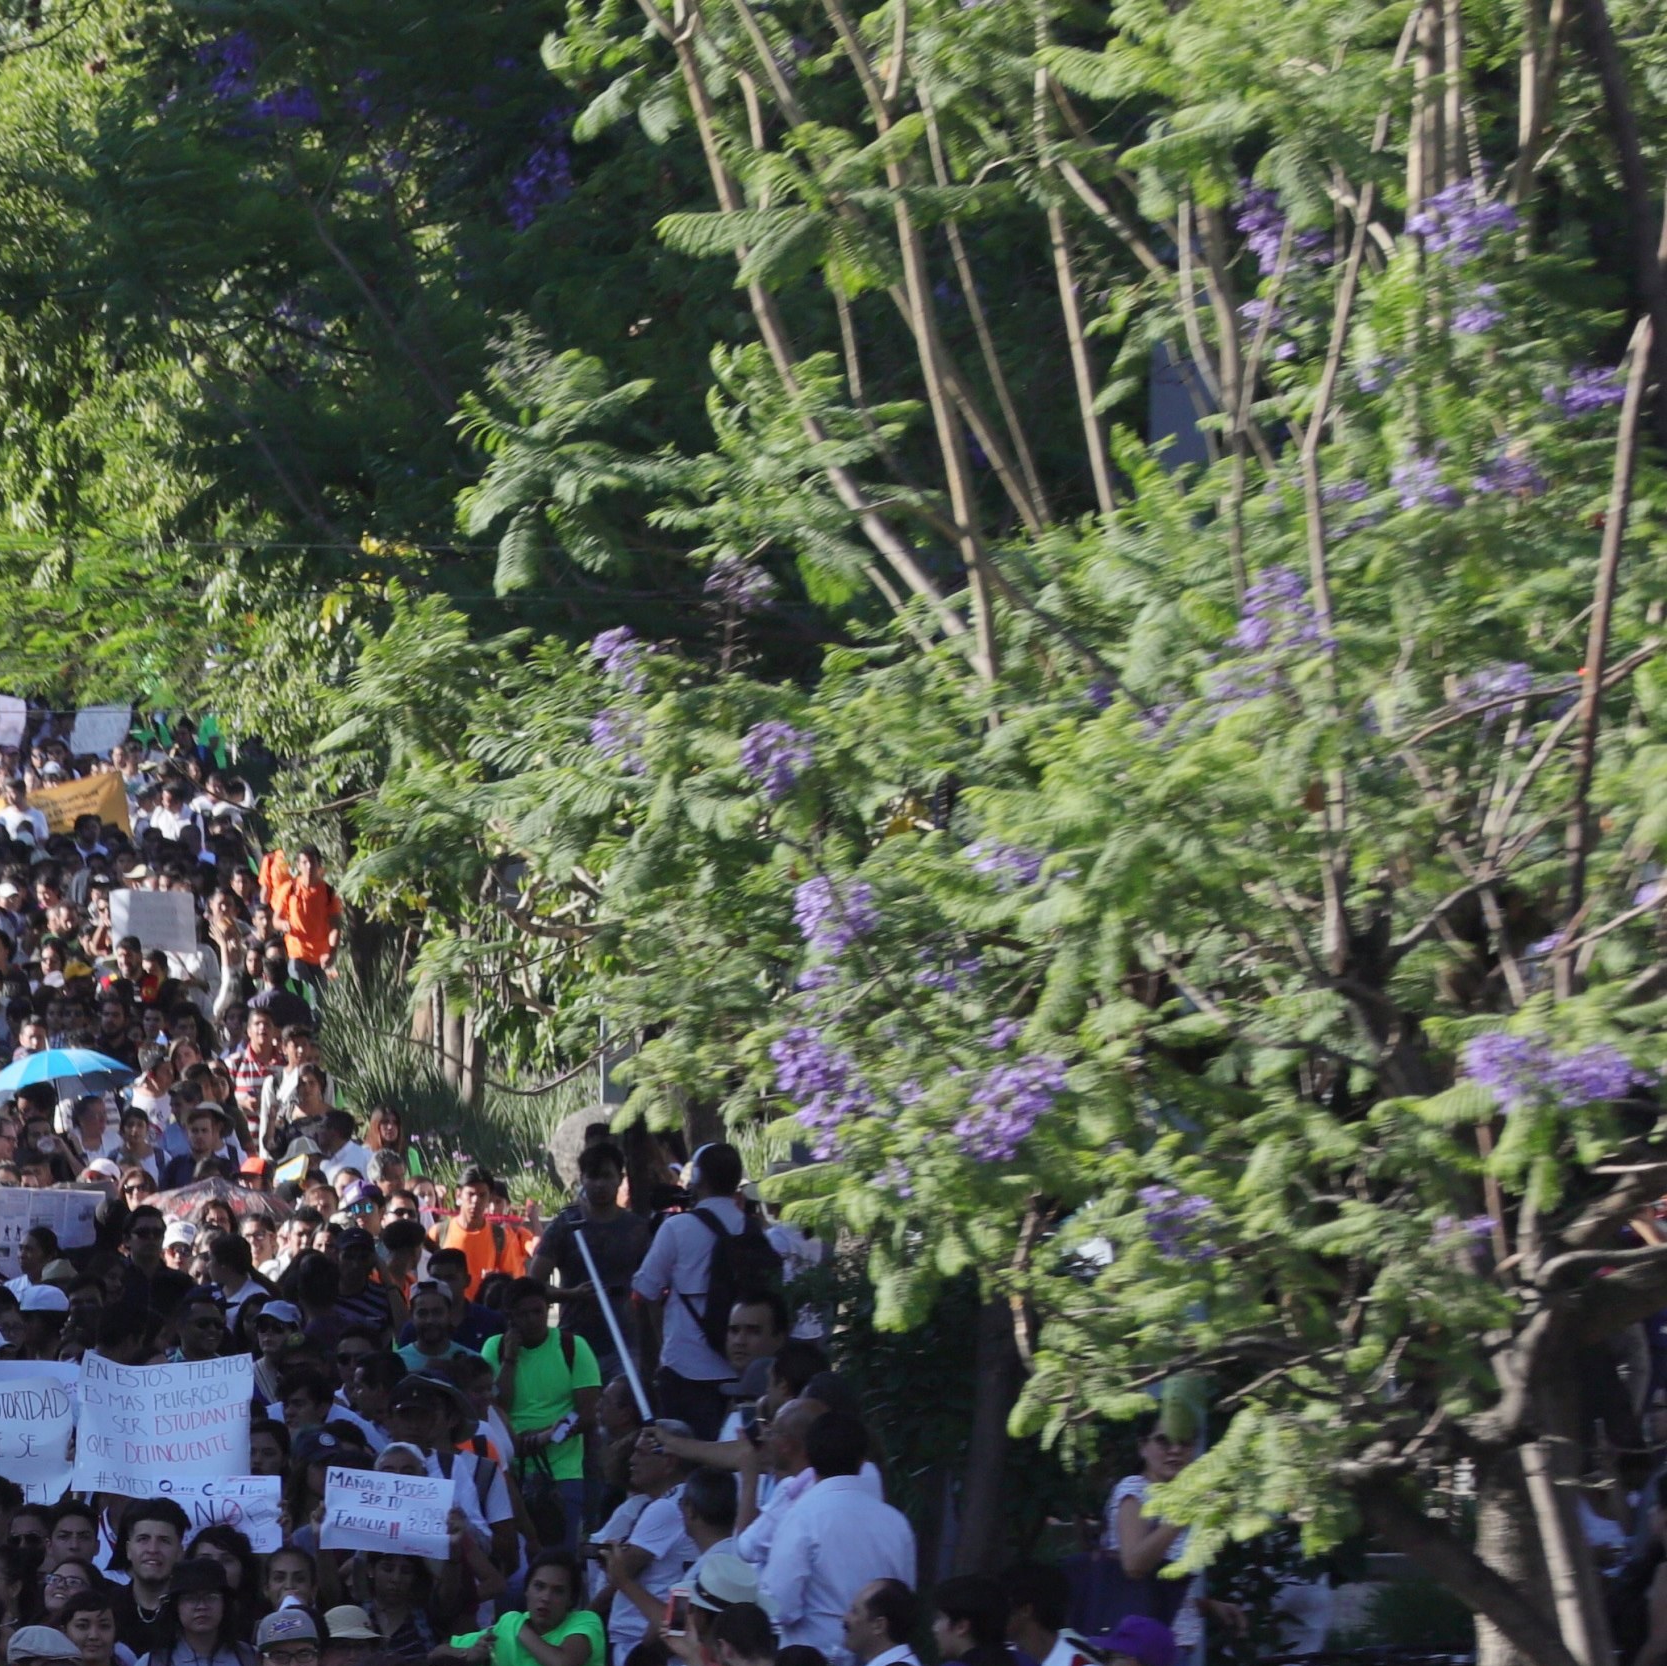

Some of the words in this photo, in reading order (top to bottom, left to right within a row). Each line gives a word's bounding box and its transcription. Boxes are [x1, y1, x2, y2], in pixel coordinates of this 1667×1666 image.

[87, 1357, 108, 1381] EN
[116, 1365, 172, 1388] ESTOS
[85, 1384, 103, 1404] ES
[109, 1393, 145, 1412] MAS
[154, 1382, 229, 1411] PELIGROSO
[111, 1415, 148, 1436] SER
[155, 1401, 251, 1436] ESTUDIANTE
[17, 1432, 39, 1458] SE
[86, 1434, 115, 1459] QUE
[124, 1432, 233, 1464] DELINCUENTE
[387, 1496, 403, 1509] TU
